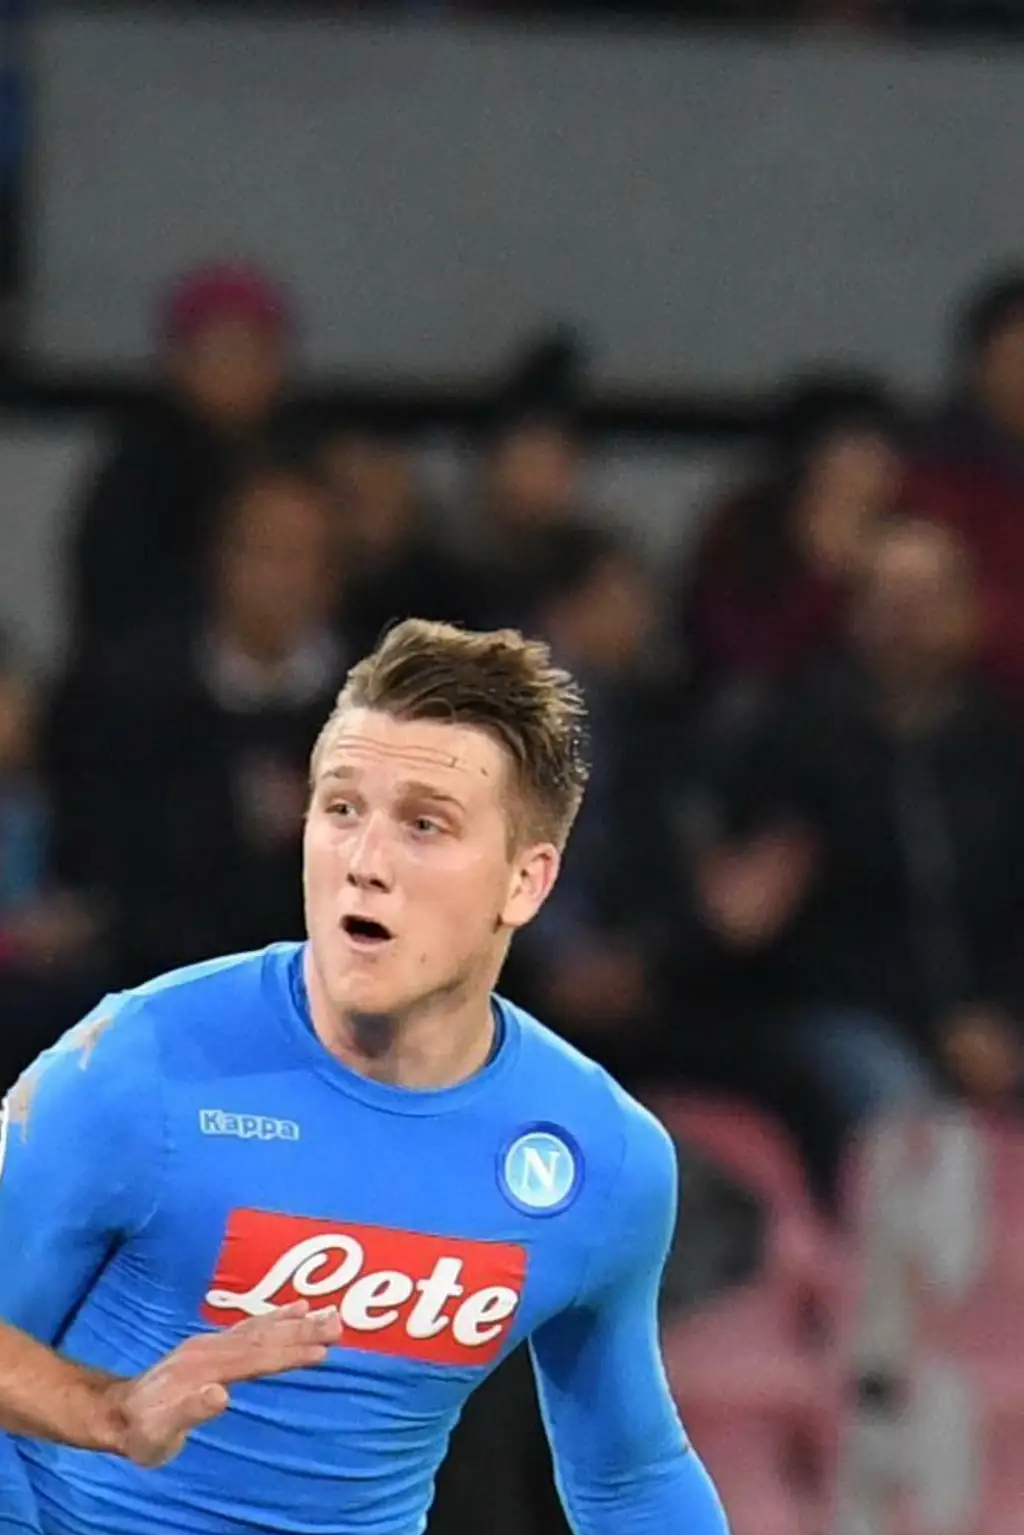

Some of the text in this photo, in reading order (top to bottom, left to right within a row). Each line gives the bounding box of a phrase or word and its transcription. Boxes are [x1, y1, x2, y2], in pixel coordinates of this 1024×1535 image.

[199, 1109, 300, 1141] Kappa
[520, 1146, 561, 1197] N
[205, 1233, 518, 1347] Lete
